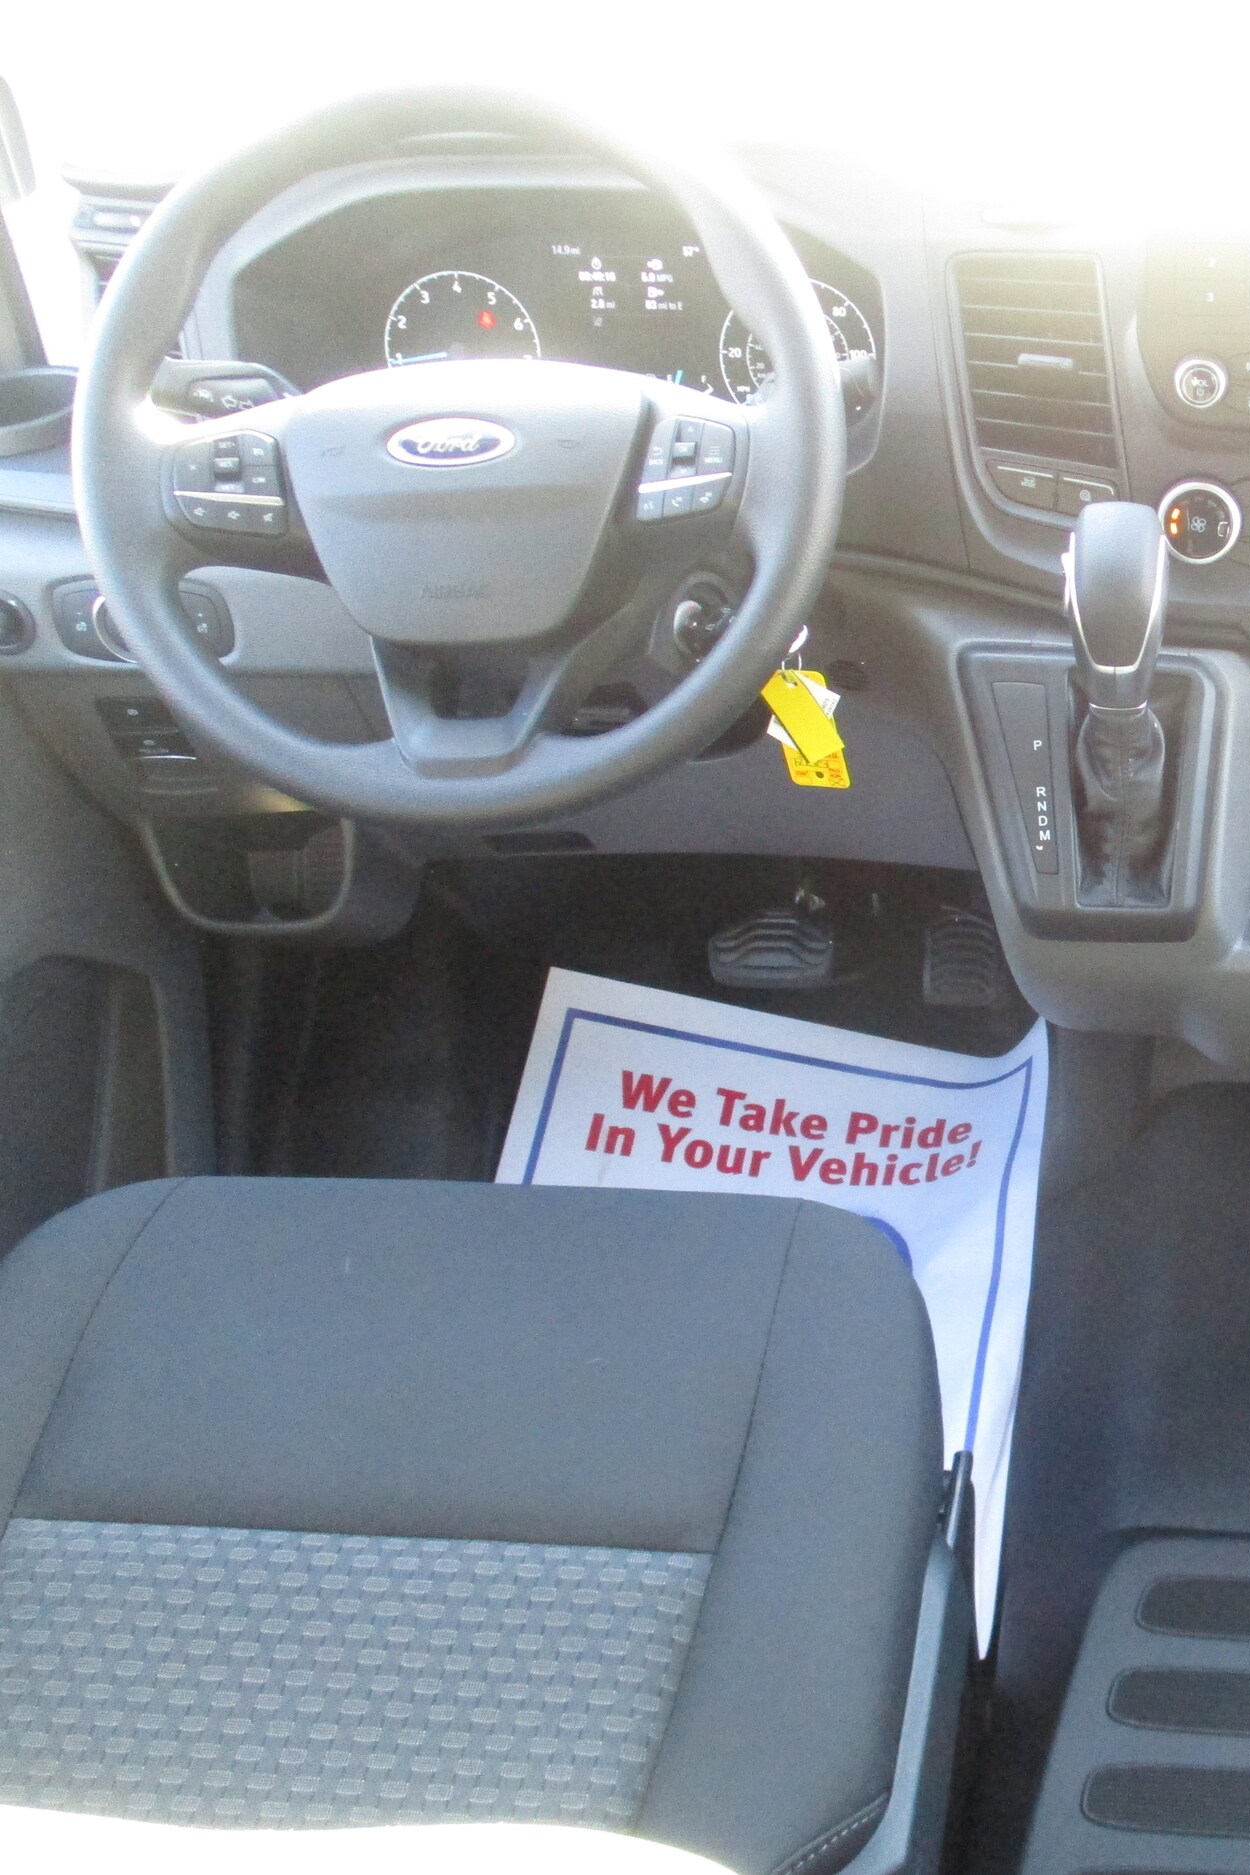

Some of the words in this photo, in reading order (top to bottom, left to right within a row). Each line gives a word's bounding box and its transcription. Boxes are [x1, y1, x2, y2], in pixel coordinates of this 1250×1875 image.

[452, 281, 462, 293] 4
[420, 290, 430, 304] 3
[487, 292, 497, 305] 5
[832, 306, 847, 317] 80
[397, 315, 407, 329] 2
[514, 318, 524, 330] 6
[728, 347, 742, 358] 20
[1033, 740, 1043, 750] P
[1036, 786, 1047, 797] R
[1037, 801, 1047, 812] N
[1038, 815, 1048, 826] D
[1039, 829, 1051, 841] M
[620, 1069, 698, 1118] We
[715, 1087, 828, 1141] Take
[845, 1111, 973, 1150] Pride
[585, 1112, 636, 1157] In
[656, 1123, 772, 1178] Your
[787, 1141, 982, 1187] Vehicle!
